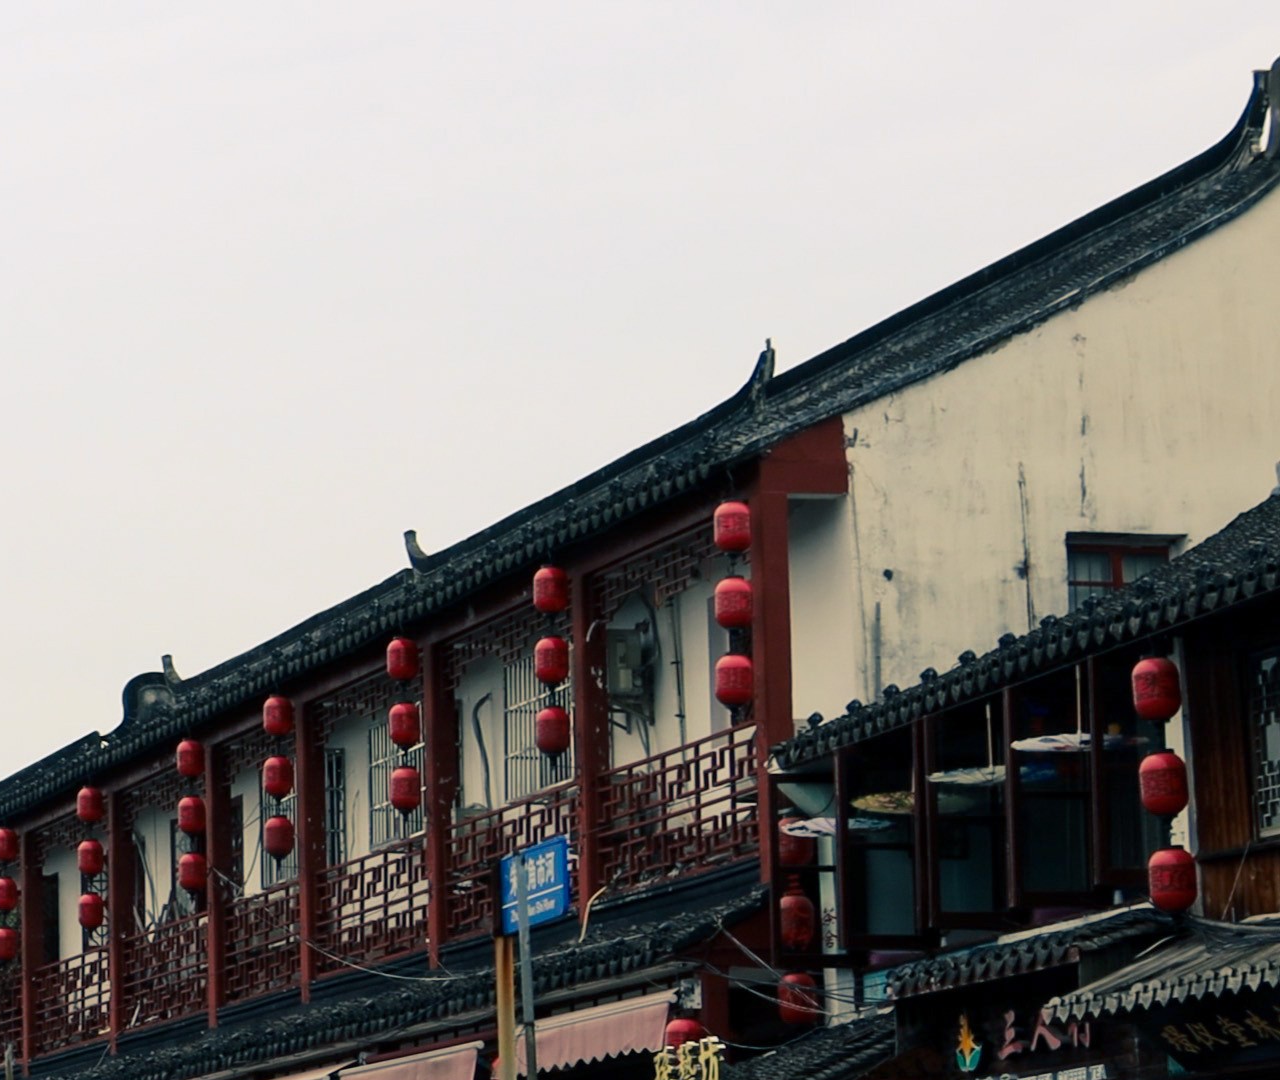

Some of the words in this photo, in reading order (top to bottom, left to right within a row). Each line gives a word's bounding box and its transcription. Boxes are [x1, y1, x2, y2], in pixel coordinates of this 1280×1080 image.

[510, 851, 555, 896] 朱角市河
[1089, 1063, 1108, 1080] TEA
